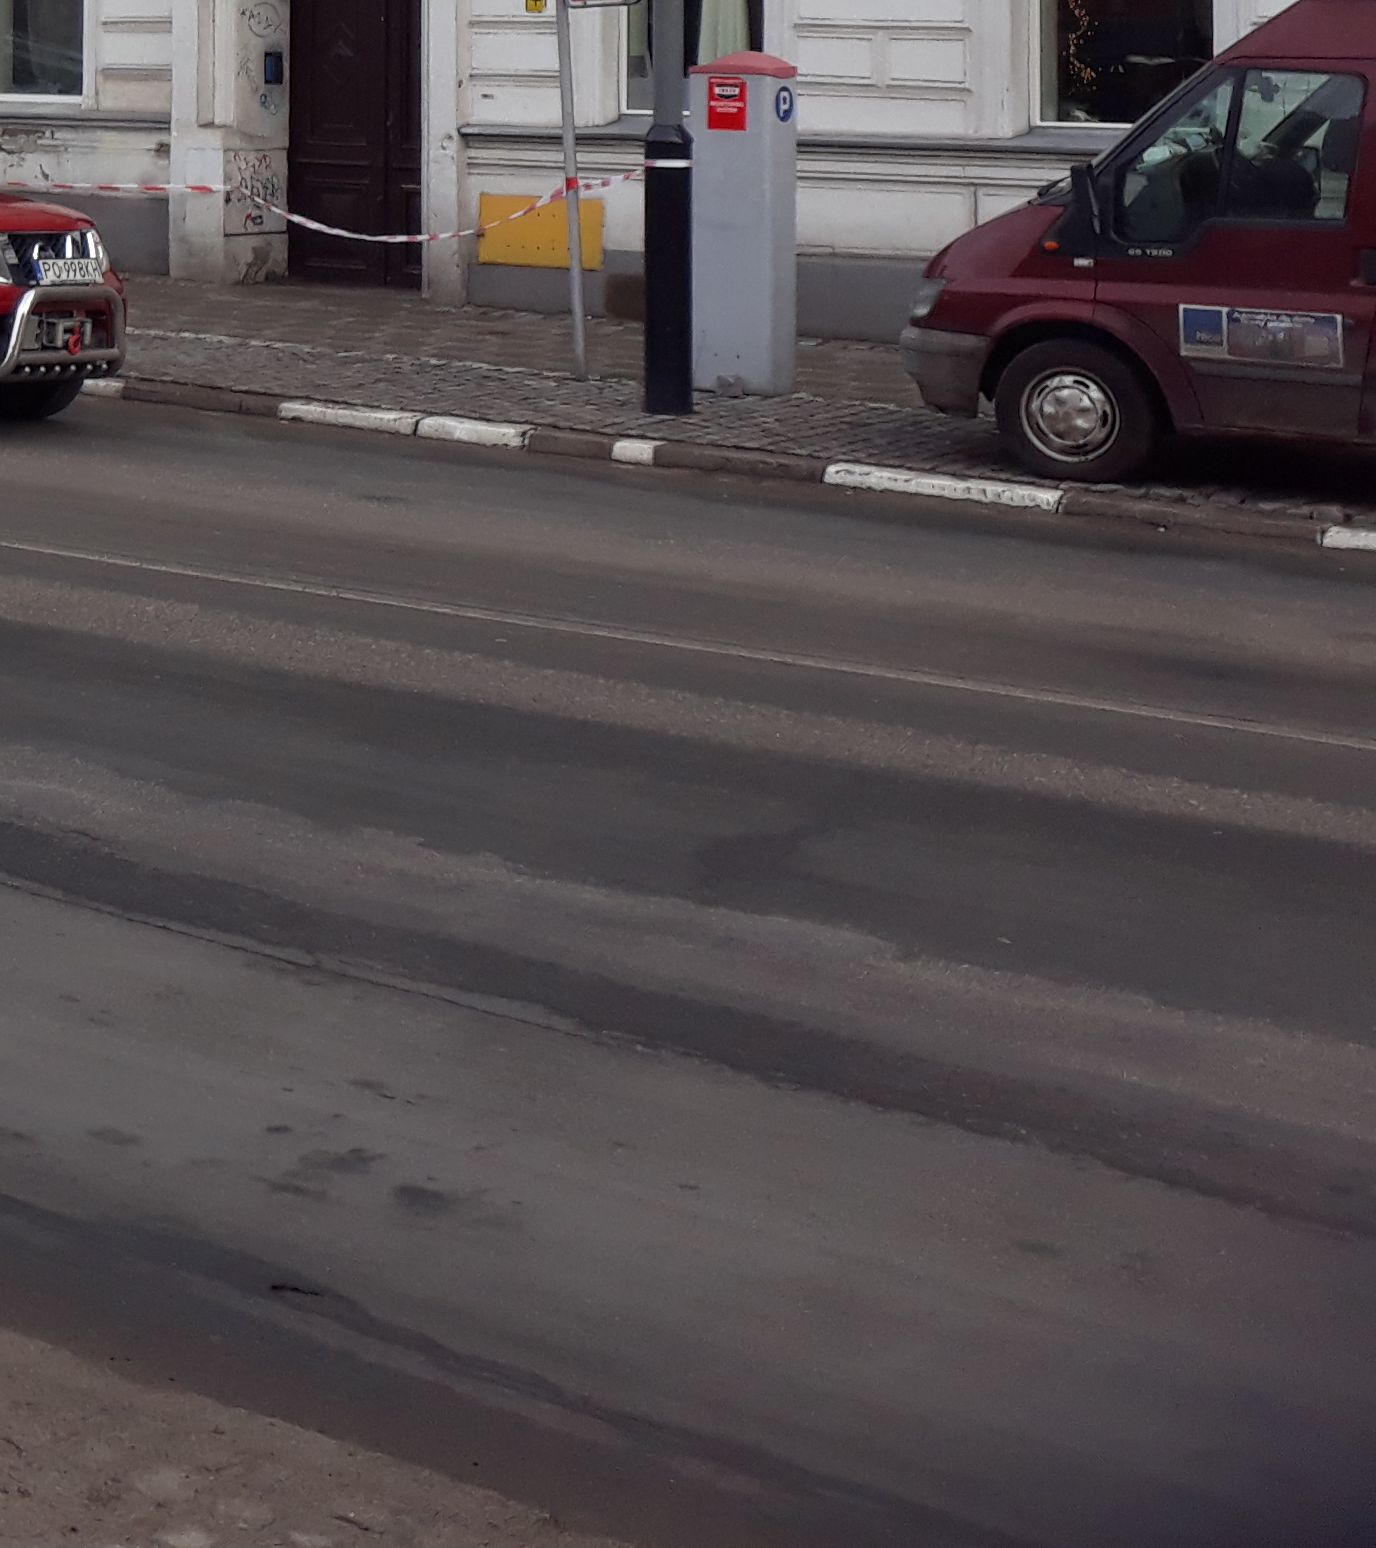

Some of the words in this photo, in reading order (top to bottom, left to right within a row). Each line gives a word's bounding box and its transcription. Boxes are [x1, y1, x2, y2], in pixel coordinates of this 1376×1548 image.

[779, 91, 791, 117] P
[41, 261, 62, 280] PO
[63, 261, 102, 279] 998KH
